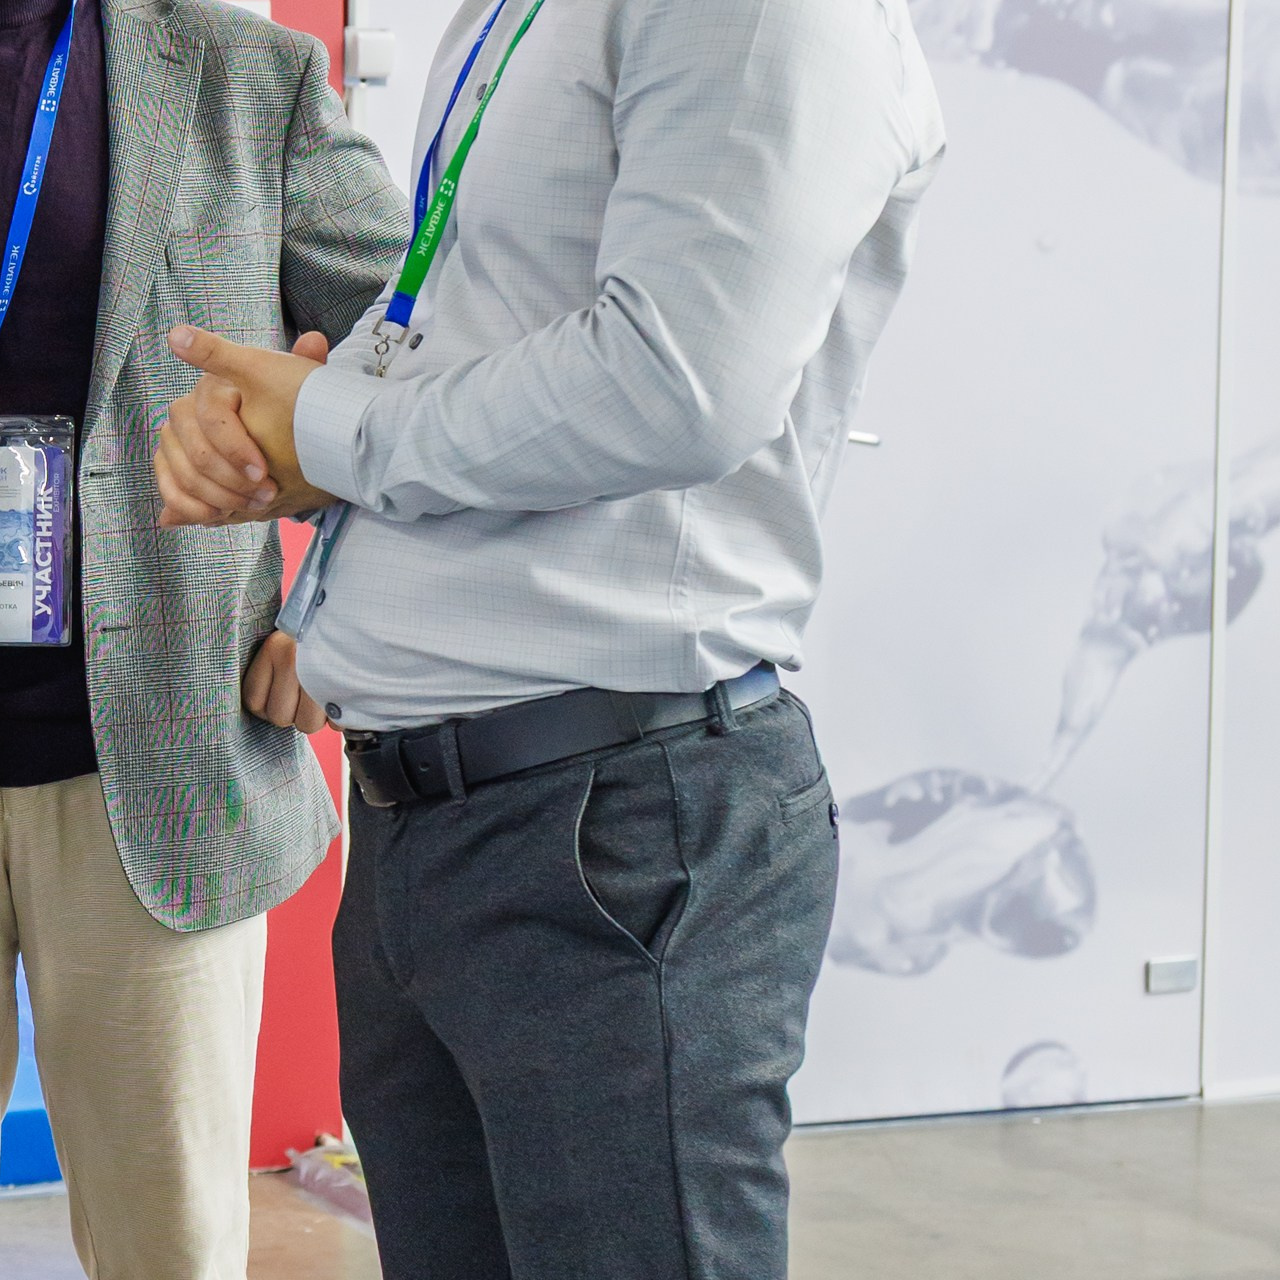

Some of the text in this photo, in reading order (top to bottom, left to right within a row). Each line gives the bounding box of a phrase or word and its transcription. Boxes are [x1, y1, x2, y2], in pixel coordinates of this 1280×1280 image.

[46, 53, 64, 98] ЭКВАТЭК
[417, 197, 447, 257] ЭКВАТЭК
[2, 245, 20, 296] ЭКВАТЭК
[34, 484, 53, 616] УЧАСТНИК
